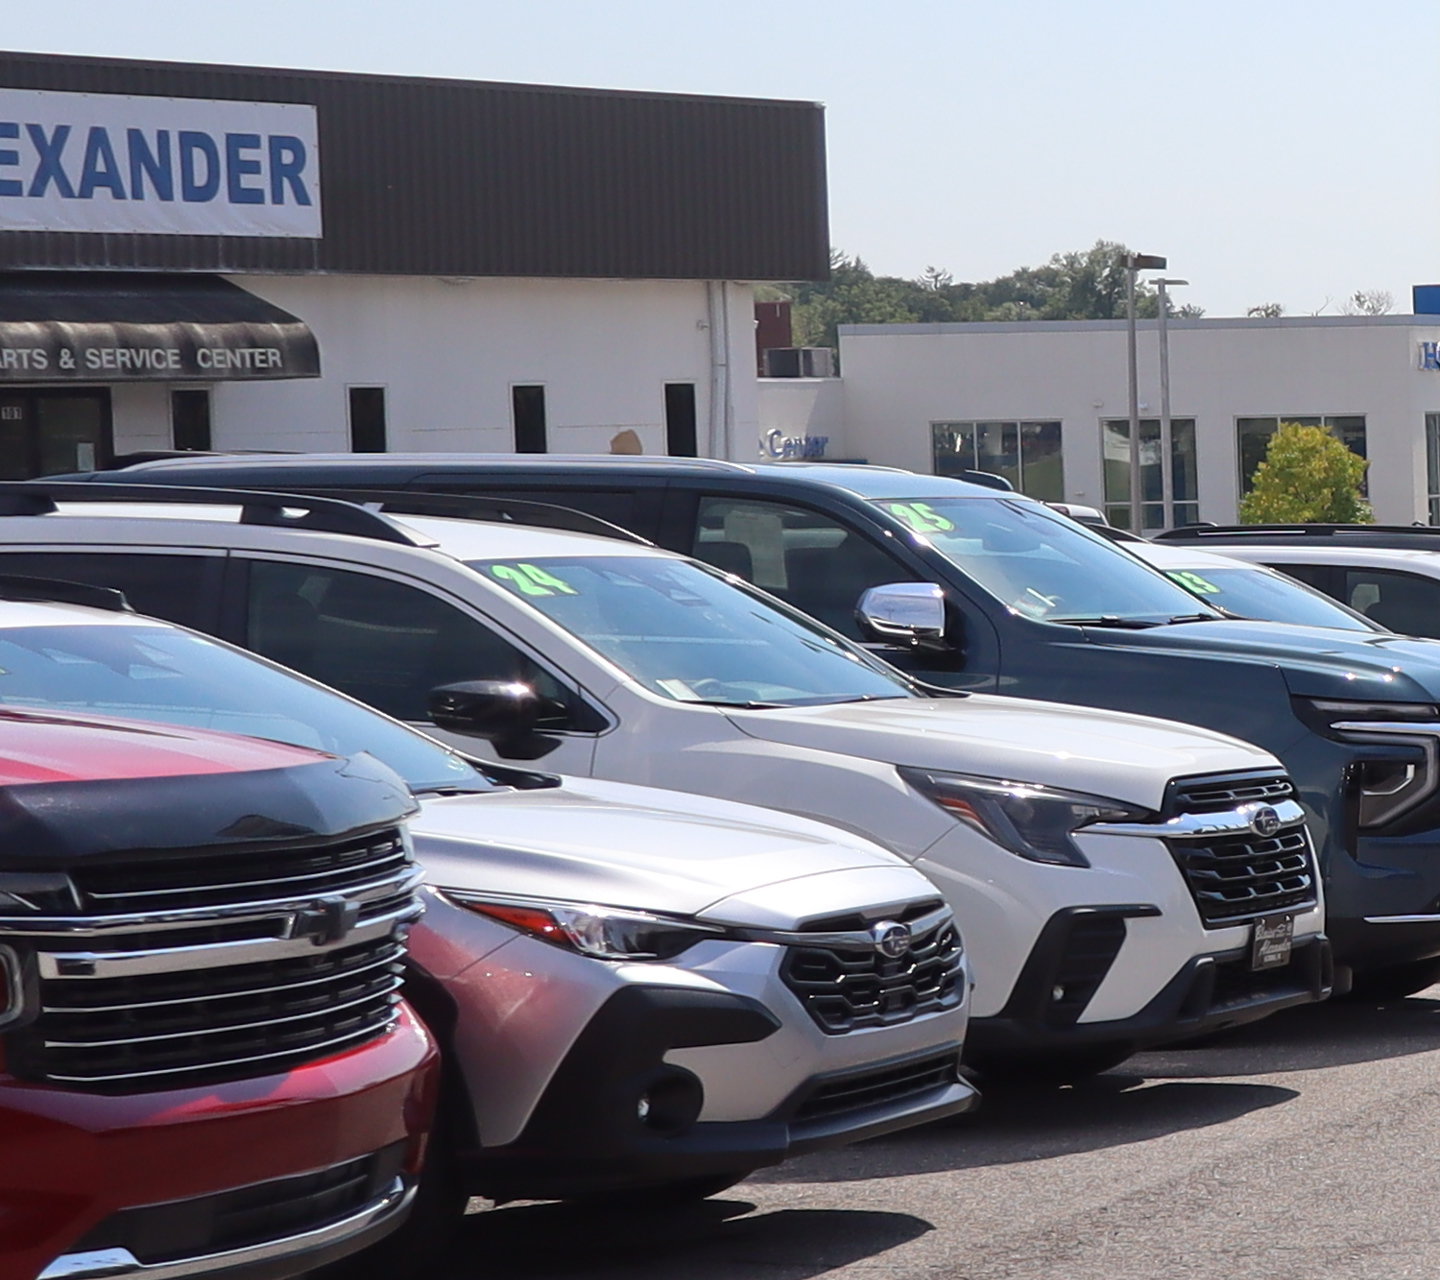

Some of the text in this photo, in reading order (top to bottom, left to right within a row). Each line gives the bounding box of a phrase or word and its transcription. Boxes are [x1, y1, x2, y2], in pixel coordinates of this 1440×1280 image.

[0, 348, 283, 370] RTS & SERVICE CENTER
[891, 503, 954, 531] 25
[492, 563, 579, 595] 24
